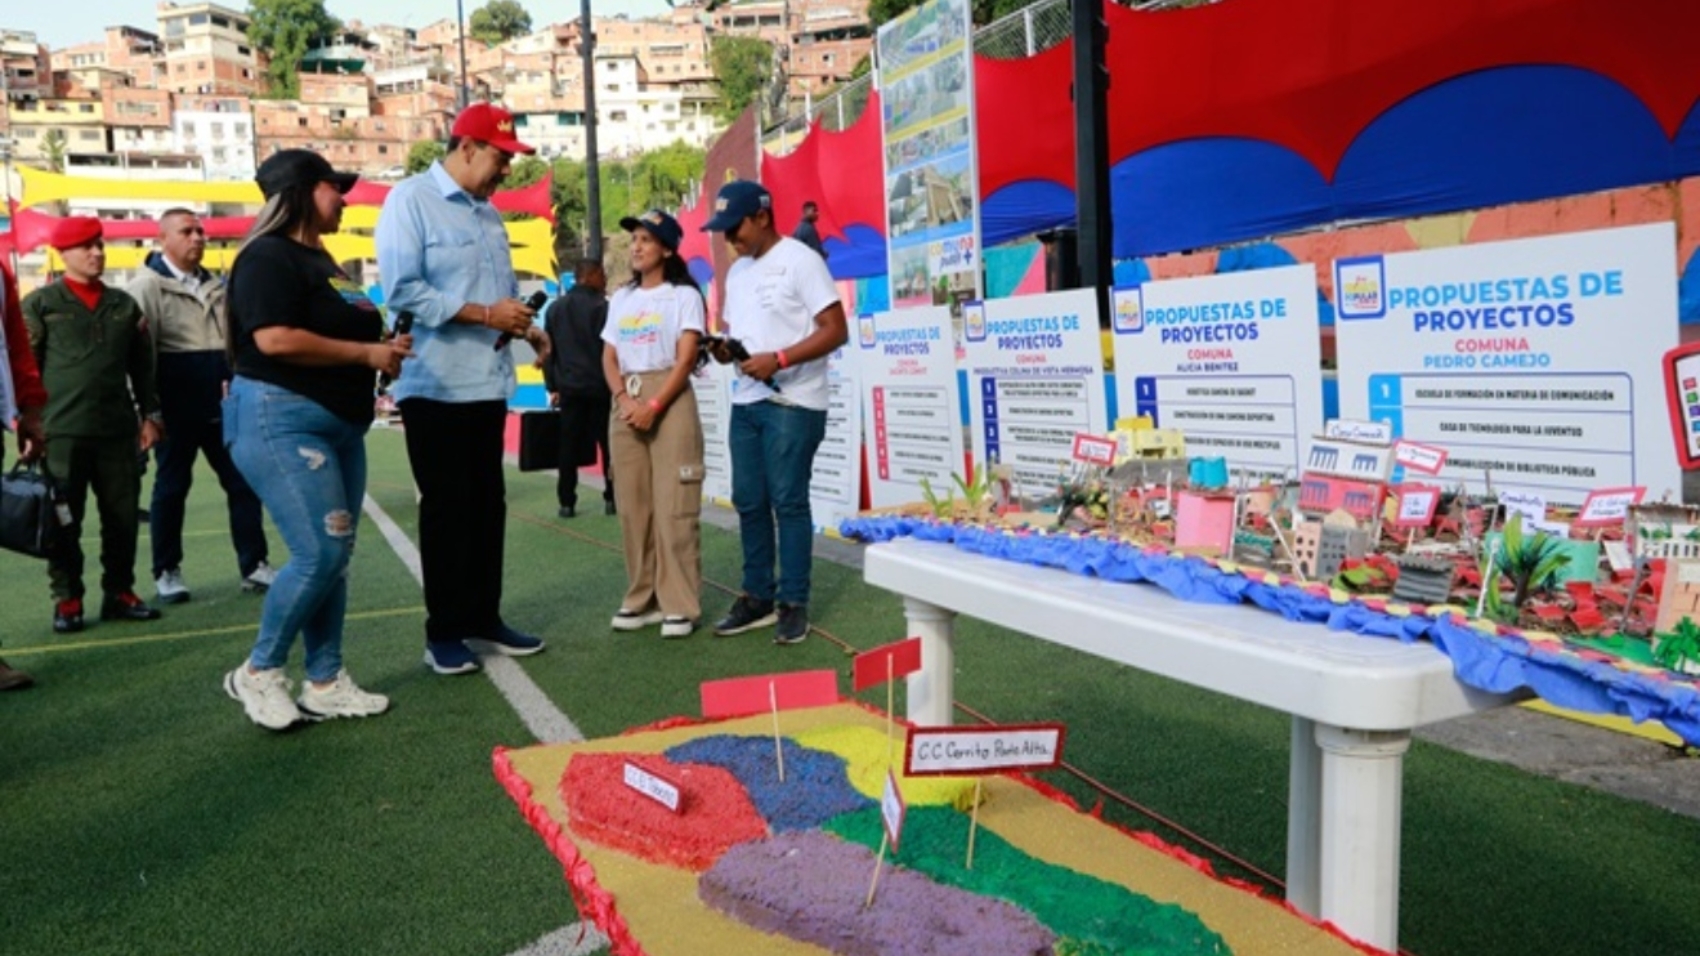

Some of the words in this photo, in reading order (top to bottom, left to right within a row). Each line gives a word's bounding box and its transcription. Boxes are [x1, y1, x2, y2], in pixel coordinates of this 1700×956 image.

[1389, 275, 1569, 309] PROPUESTAS
[1579, 271, 1623, 297] DE
[1146, 301, 1255, 325] PROPUESTAS
[1260, 299, 1287, 318] DE
[1414, 303, 1575, 332] PROYECTOS
[987, 317, 1060, 335] PROPUESTAS
[1063, 316, 1079, 330] DE
[1161, 323, 1259, 344] PROYECTOS
[998, 334, 1063, 350] PROYECTOS
[1455, 338, 1530, 353] COMUNA
[1187, 349, 1233, 360] COMUNA
[1424, 354, 1477, 369] PEDRO
[1481, 353, 1551, 368] CAMEJO
[1381, 384, 1389, 398] 1
